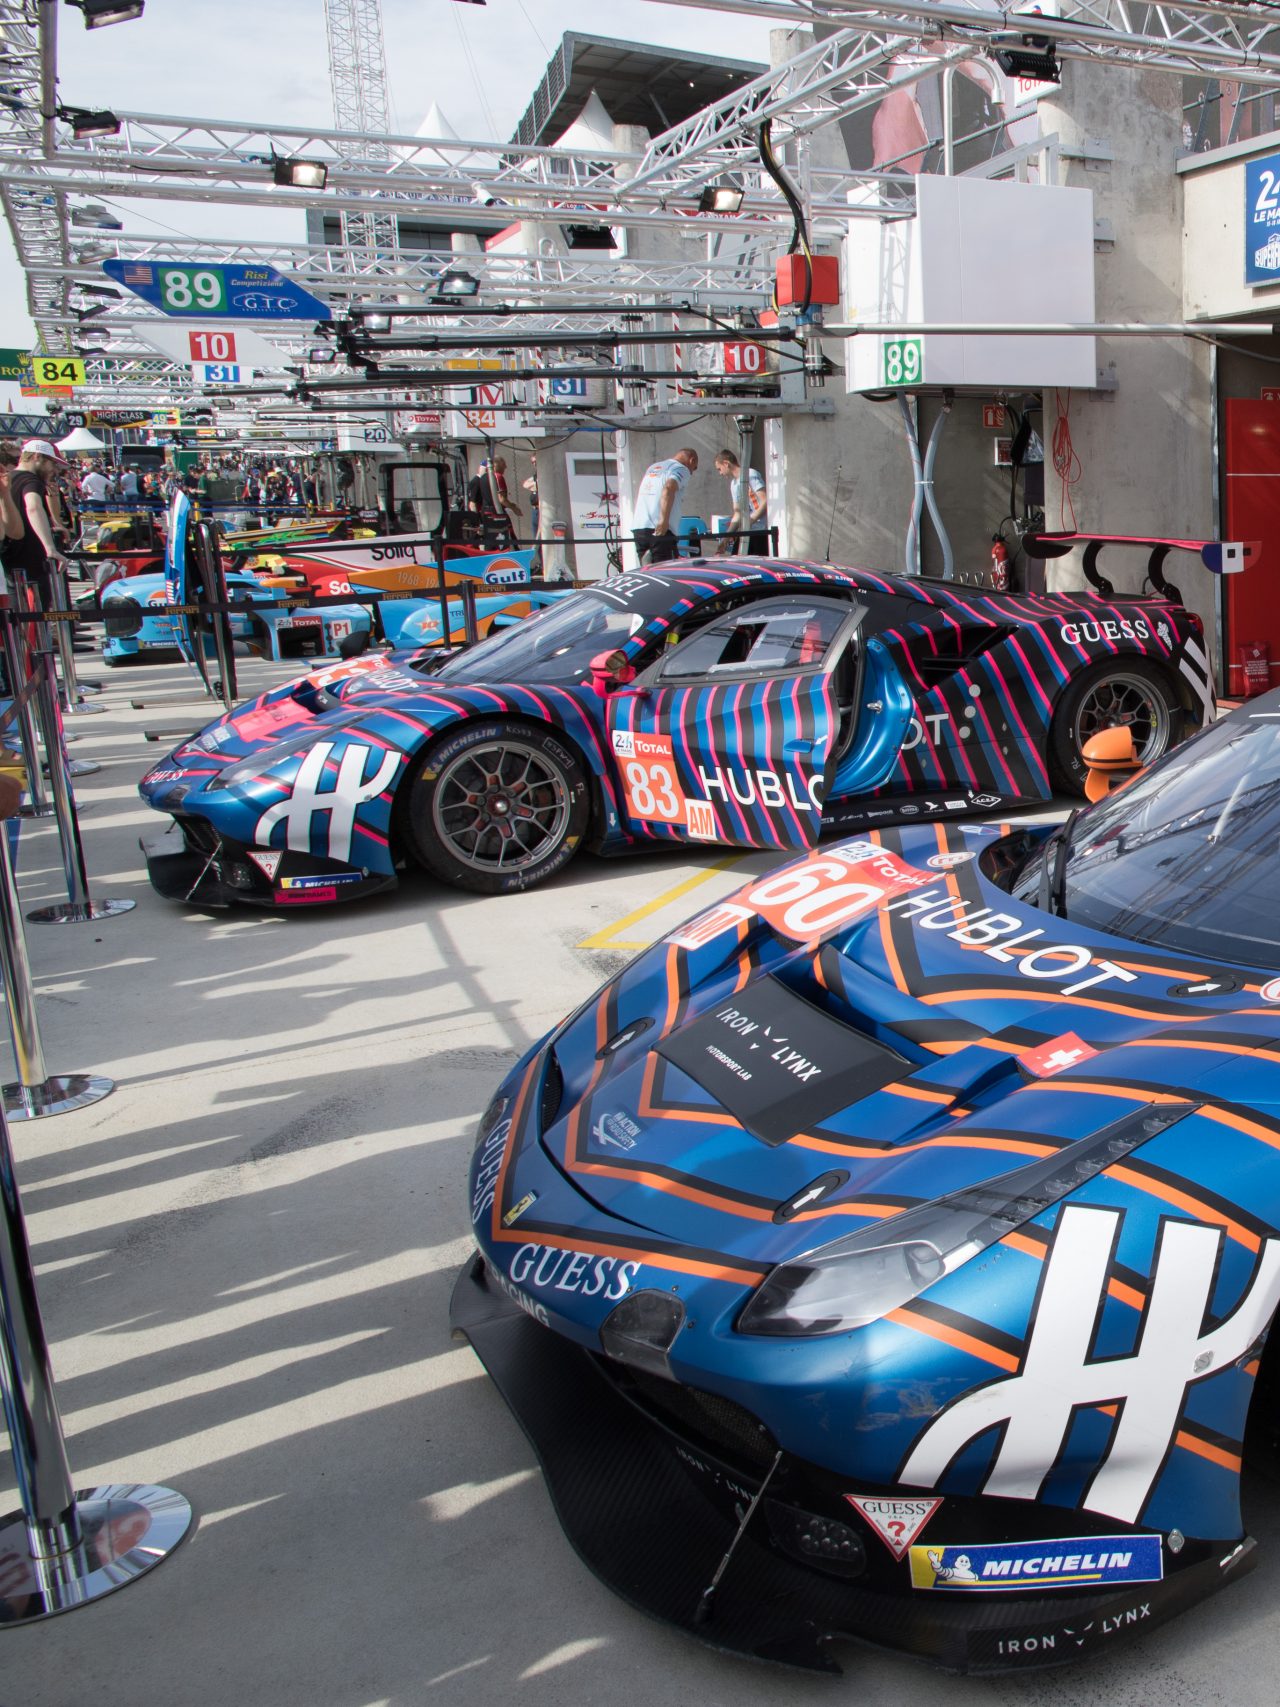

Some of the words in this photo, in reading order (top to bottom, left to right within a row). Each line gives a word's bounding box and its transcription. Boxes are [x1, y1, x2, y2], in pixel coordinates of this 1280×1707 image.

[1253, 211, 1267, 223] LE
[245, 270, 269, 279] Risi
[164, 270, 222, 309] 89
[195, 334, 229, 359] 10
[729, 345, 760, 371] 10
[887, 342, 921, 384] 89
[42, 362, 78, 381] 84
[209, 364, 237, 382] 31
[557, 376, 583, 395] 31
[68, 415, 83, 426] 29
[97, 411, 117, 419] HIGH
[119, 411, 144, 419] CLASS
[152, 413, 167, 425] 49
[469, 409, 495, 427] 84
[366, 429, 386, 443] 20
[486, 570, 526, 584] Gulf
[383, 591, 413, 600] Ferrari
[477, 584, 506, 592] Ferrari
[165, 605, 200, 615] Ferrari
[277, 600, 310, 608] Ferrari
[44, 611, 81, 621] Ferrari
[293, 617, 322, 626] TOTAL
[334, 622, 349, 636] P1
[1060, 619, 1149, 645] GUESS
[440, 728, 497, 763] MICHELIN
[635, 740, 671, 754] TOTAL
[626, 762, 679, 818] 83
[689, 806, 714, 837] AM
[508, 853, 563, 887] MICHELIN
[872, 856, 928, 886] TOTAL
[749, 862, 885, 932] 60
[882, 889, 1139, 997] HUBLOT
[715, 1007, 759, 1036] IRON
[771, 1046, 821, 1082] LYNX
[705, 1045, 742, 1072] MOTORSPORT
[737, 1069, 752, 1081] LAB
[473, 1118, 512, 1224] GUESS
[510, 1242, 642, 1301] GUESS
[982, 1552, 1133, 1575] MICHELIN
[998, 1635, 1055, 1654] IRON
[1102, 1602, 1151, 1633] LYNX
